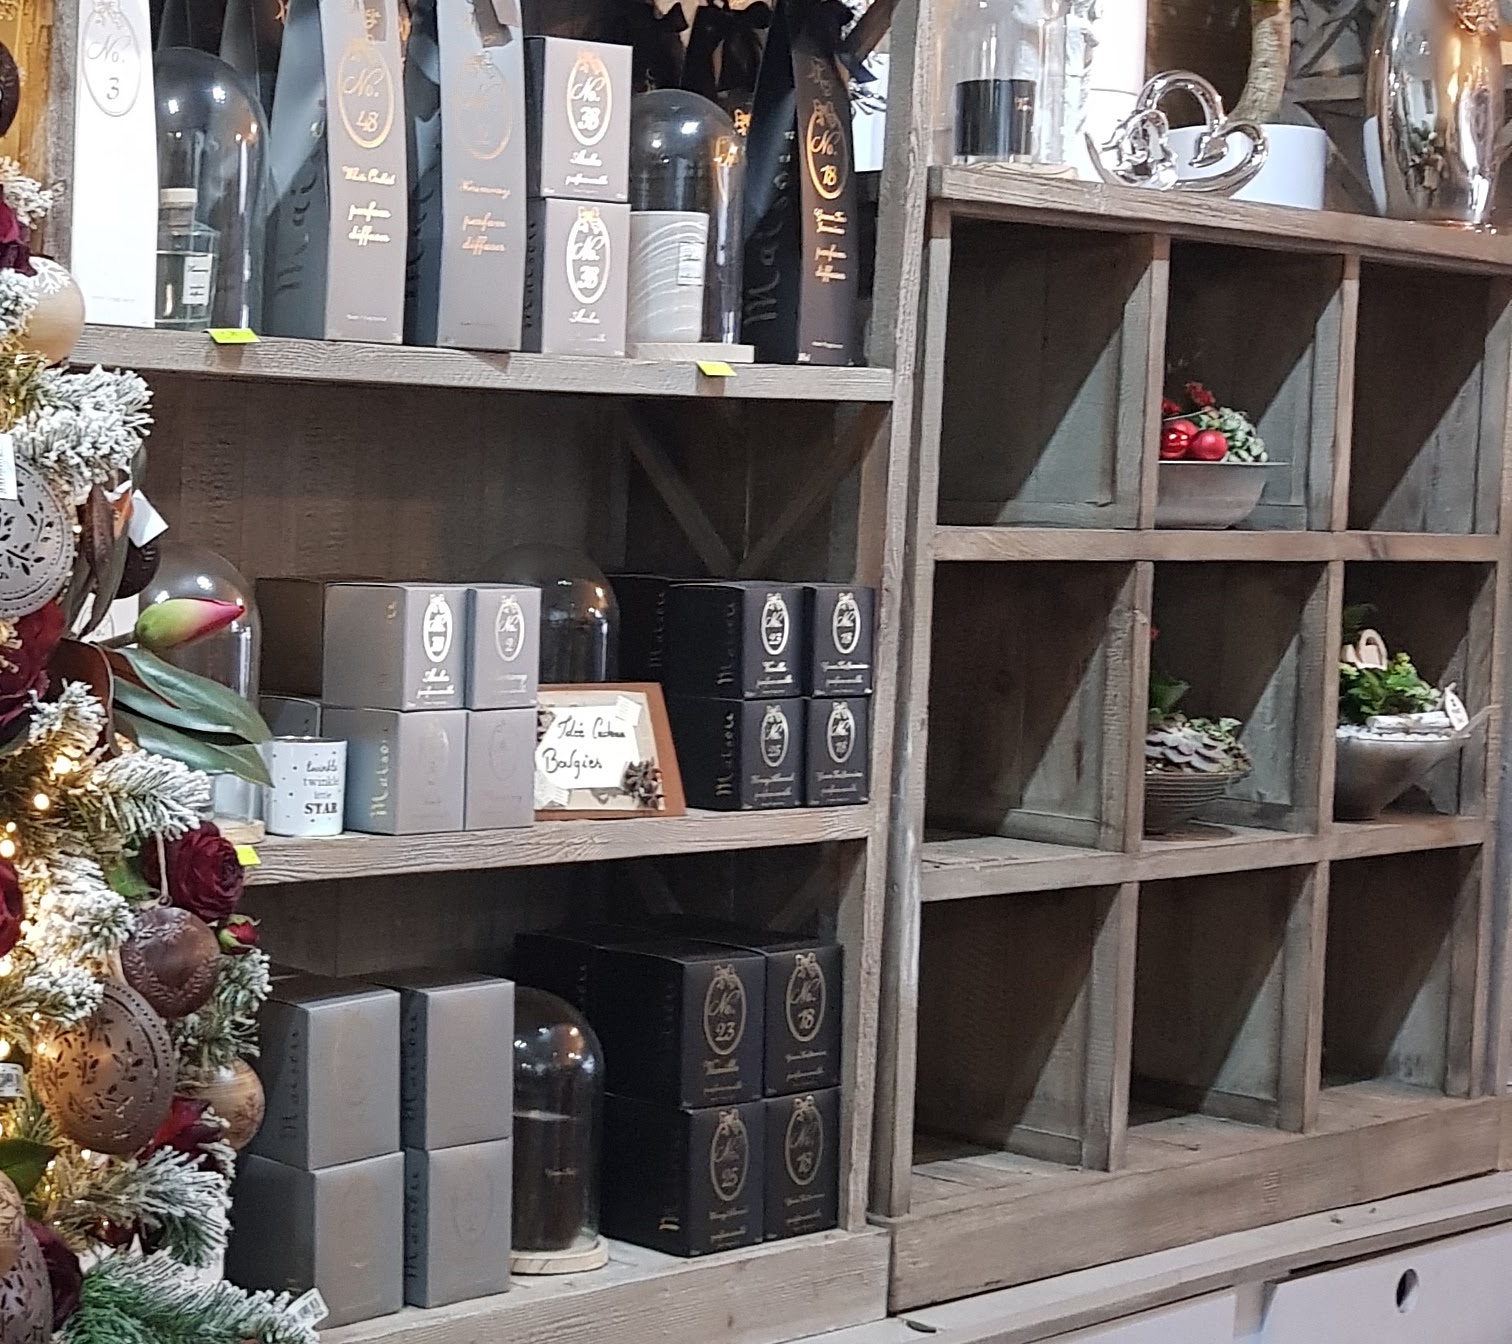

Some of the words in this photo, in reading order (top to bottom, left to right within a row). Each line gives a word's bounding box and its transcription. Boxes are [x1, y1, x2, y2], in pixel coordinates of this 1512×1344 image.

[87, 33, 132, 64] No.
[106, 76, 120, 100] 3
[343, 67, 386, 98] No.
[571, 76, 607, 102] No.
[355, 110, 380, 133] 48
[577, 105, 602, 131] 38
[819, 164, 838, 186] 18
[348, 224, 391, 247] diffuser
[576, 264, 600, 290] 38
[304, 802, 338, 815] STAR
[714, 1021, 737, 1042] 23
